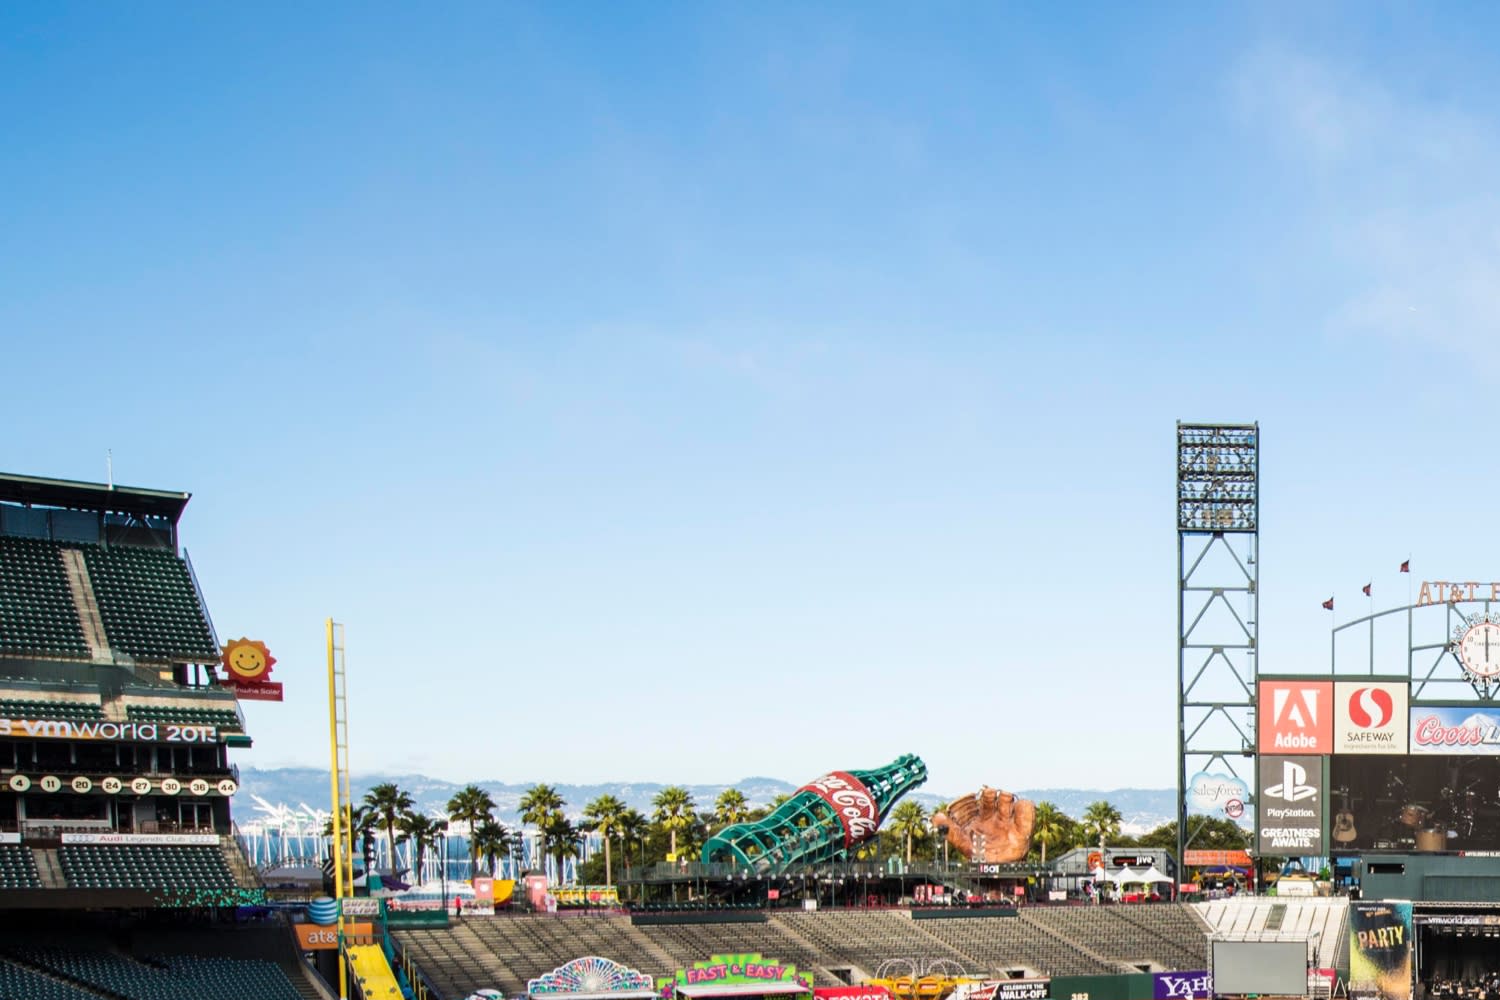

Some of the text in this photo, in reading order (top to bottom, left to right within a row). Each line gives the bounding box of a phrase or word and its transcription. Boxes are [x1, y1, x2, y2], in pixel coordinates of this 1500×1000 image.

[1416, 581, 1480, 607] AT&T
[22, 720, 157, 741] vmworld
[166, 726, 217, 743] 2013
[1414, 715, 1482, 746] Coors
[1274, 732, 1318, 749] Adobe
[1347, 732, 1394, 743] SAFEWAY
[15, 779, 24, 788] 4
[46, 780, 55, 789] 11
[75, 781, 89, 790] 20
[105, 781, 119, 790] 24
[135, 782, 148, 791] 27
[165, 783, 178, 792] 30
[193, 783, 206, 792] 36
[221, 783, 234, 792] 44
[1193, 783, 1243, 801] salesforce
[1261, 828, 1321, 839] GREATNESS
[126, 836, 164, 845] Legends
[308, 930, 338, 944] at&
[1357, 926, 1404, 949] PARTY
[687, 963, 785, 984] FAST & EASY
[1000, 990, 1047, 1000] WALK-OFF
